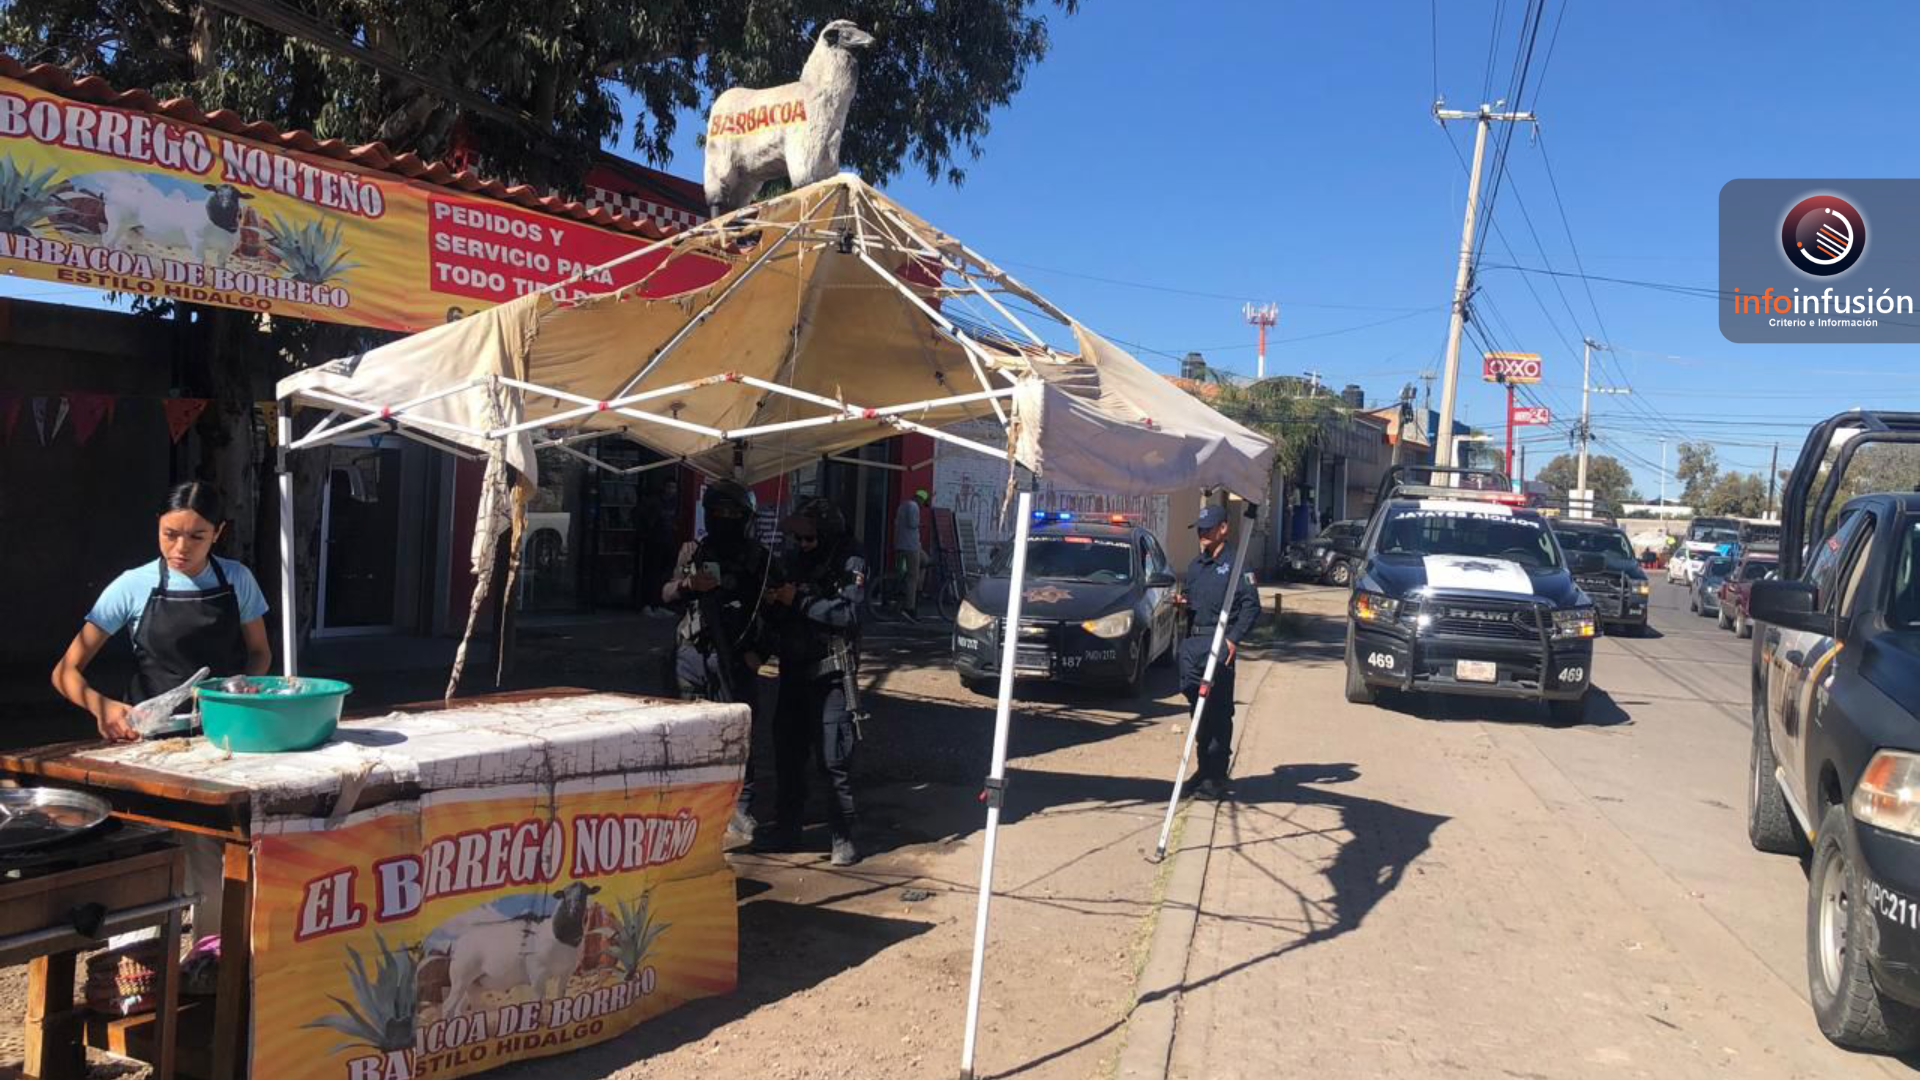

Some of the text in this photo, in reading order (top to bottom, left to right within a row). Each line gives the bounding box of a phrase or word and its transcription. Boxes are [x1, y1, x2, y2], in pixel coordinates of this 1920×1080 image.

[709, 99, 807, 136] BARBACOA
[0, 94, 384, 218] BORREGO NORTEÑO
[434, 202, 564, 246] PEDIDOS Y
[434, 231, 550, 272] SERVICIO
[57, 268, 272, 310] ESTILO HIDALGO
[163, 258, 205, 287] DE
[211, 266, 350, 309] BORREGO
[435, 262, 506, 291] TODO
[1489, 360, 1539, 376] OXXO
[1367, 652, 1395, 669] 469
[1558, 667, 1583, 682] 469
[298, 869, 363, 938] EL
[573, 811, 698, 875] NORTEÑO
[496, 1001, 542, 1037] DE
[415, 1020, 604, 1078] STILO HIDALGO
